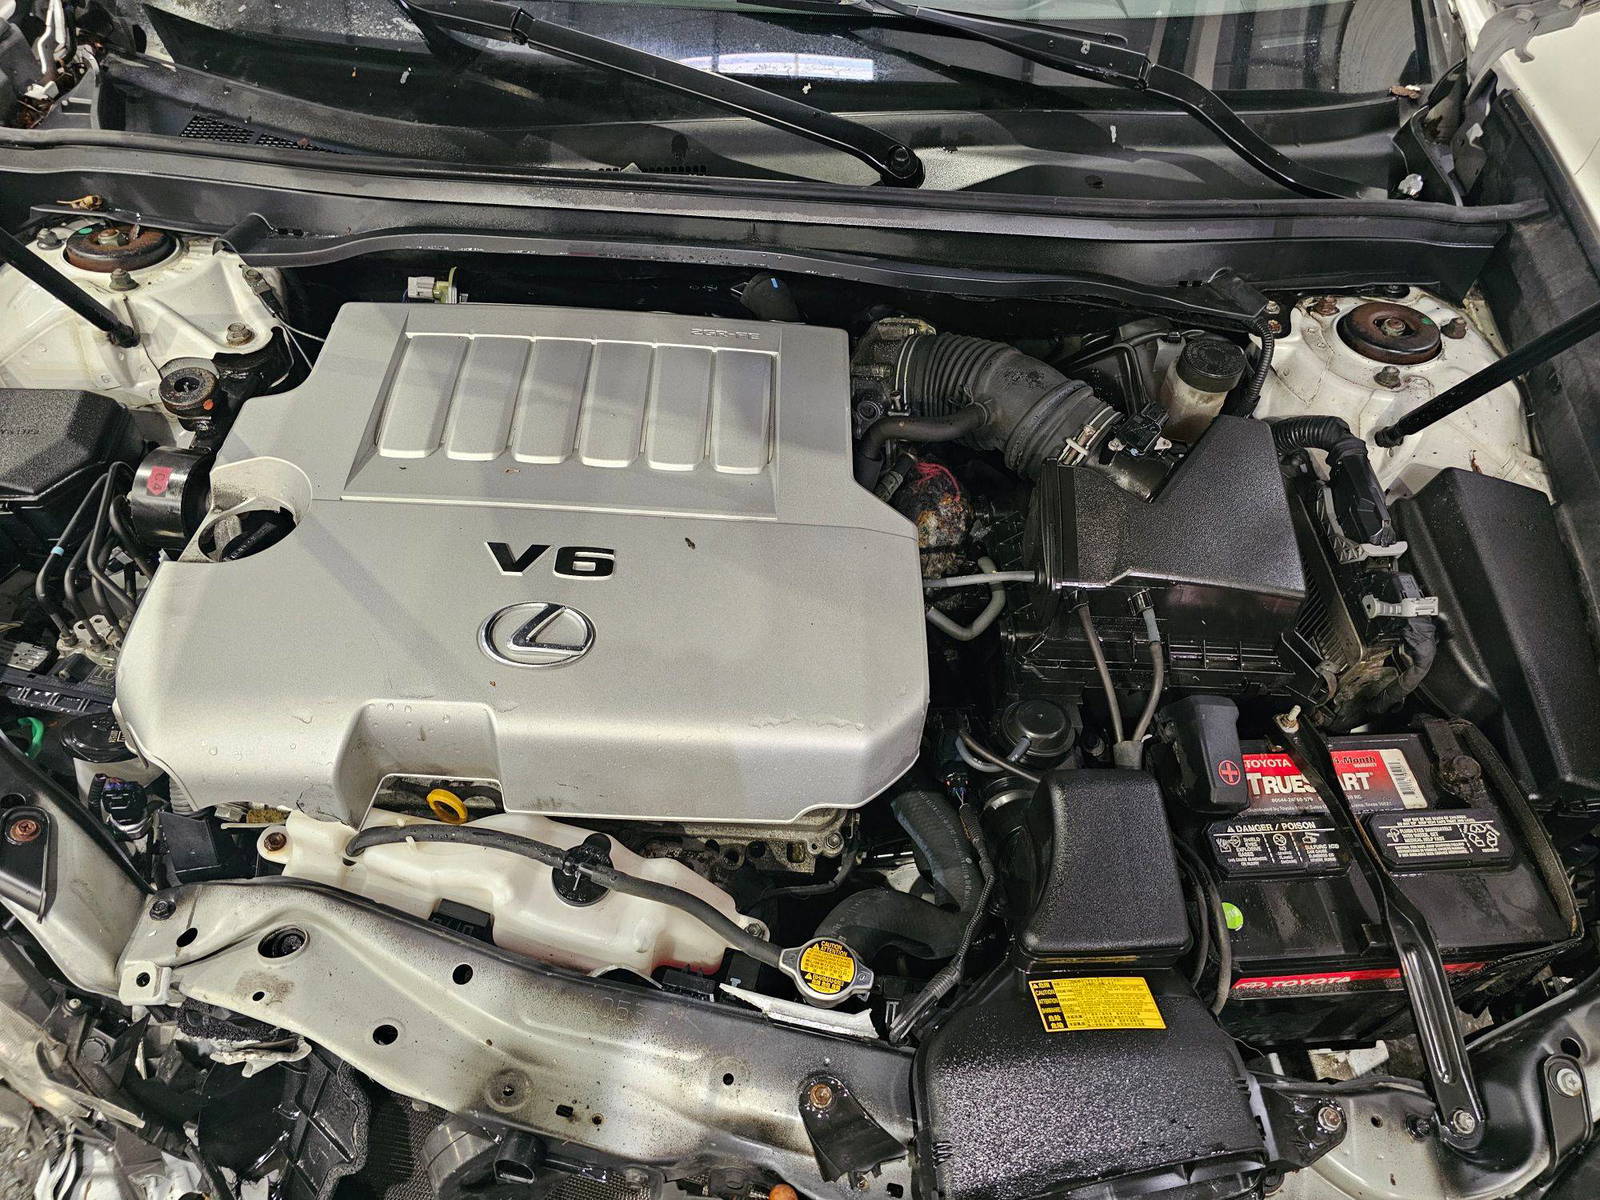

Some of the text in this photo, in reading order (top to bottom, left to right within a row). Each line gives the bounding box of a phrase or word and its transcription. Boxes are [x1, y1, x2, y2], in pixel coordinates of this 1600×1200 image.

[484, 541, 615, 581] V6
[1245, 758, 1292, 768] TOYOTA
[1235, 823, 1273, 833] DANGER
[1281, 821, 1316, 831] POISON
[821, 941, 843, 951] CAUTION
[1271, 976, 1351, 988] TOYOTA
